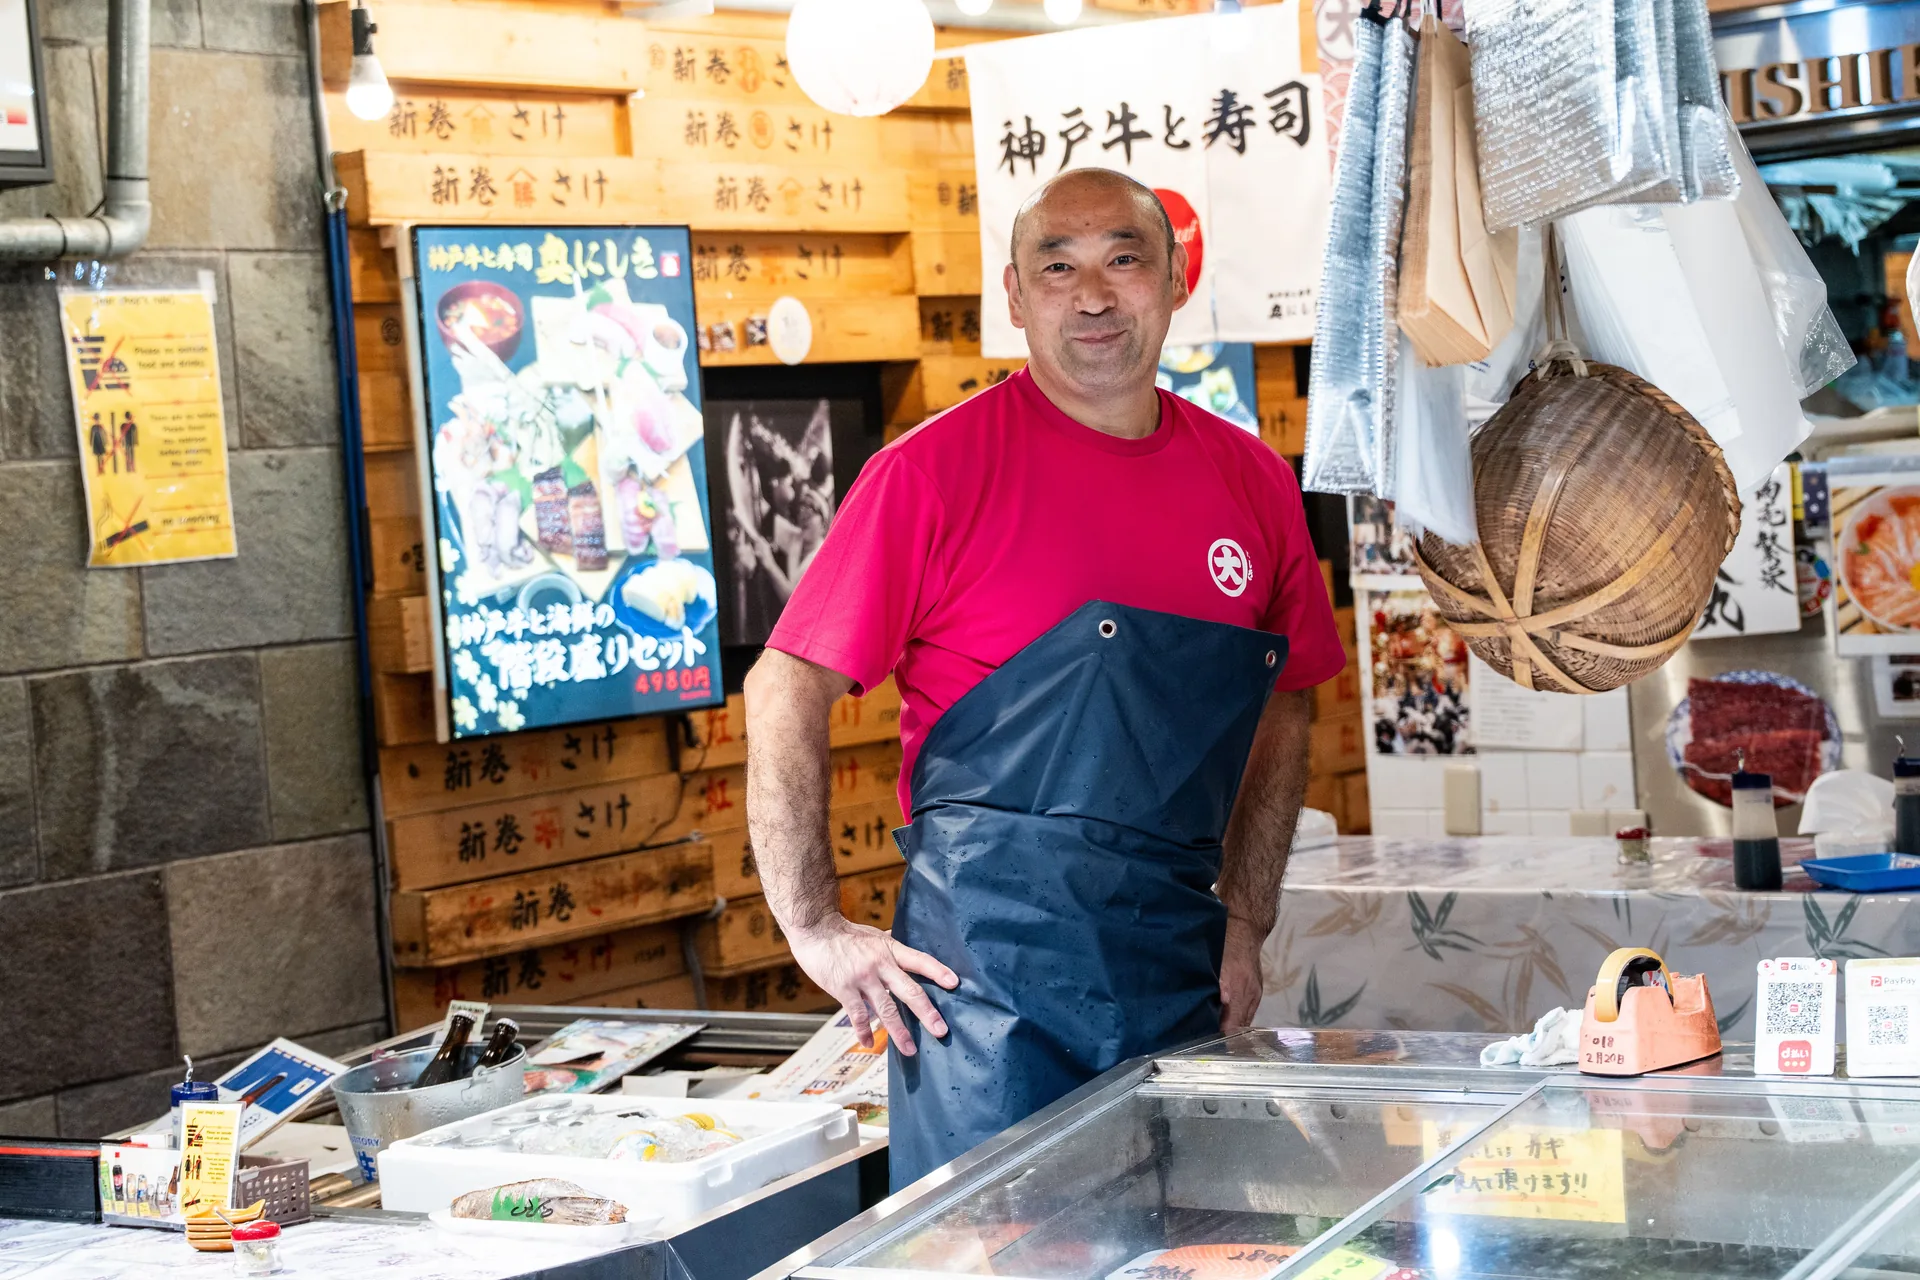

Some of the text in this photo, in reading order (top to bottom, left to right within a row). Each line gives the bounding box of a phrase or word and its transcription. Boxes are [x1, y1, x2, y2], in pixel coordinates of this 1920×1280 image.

[673, 46, 732, 85] 新巻
[388, 101, 456, 141] 新巻
[508, 102, 567, 141] さけ
[683, 110, 834, 153] 新巻 さけ
[998, 81, 1313, 176] 神戸牛と寿司
[431, 165, 497, 207] 新巻
[550, 168, 608, 208] さけ
[714, 175, 864, 214] 新巻 さけ
[535, 231, 658, 285] 奥にしき
[692, 243, 845, 282] 新巻 さけ
[498, 626, 707, 691] 階段盛りセット
[635, 665, 711, 695] 4980円
[444, 724, 618, 791] 新巻 さけ
[459, 813, 526, 863] 新巻
[575, 792, 632, 838] さけ
[839, 814, 886, 857] さけ
[511, 882, 577, 931] 新巻
[1883, 976, 1917, 986] PayPay
[1781, 1047, 1809, 1059] d払い
